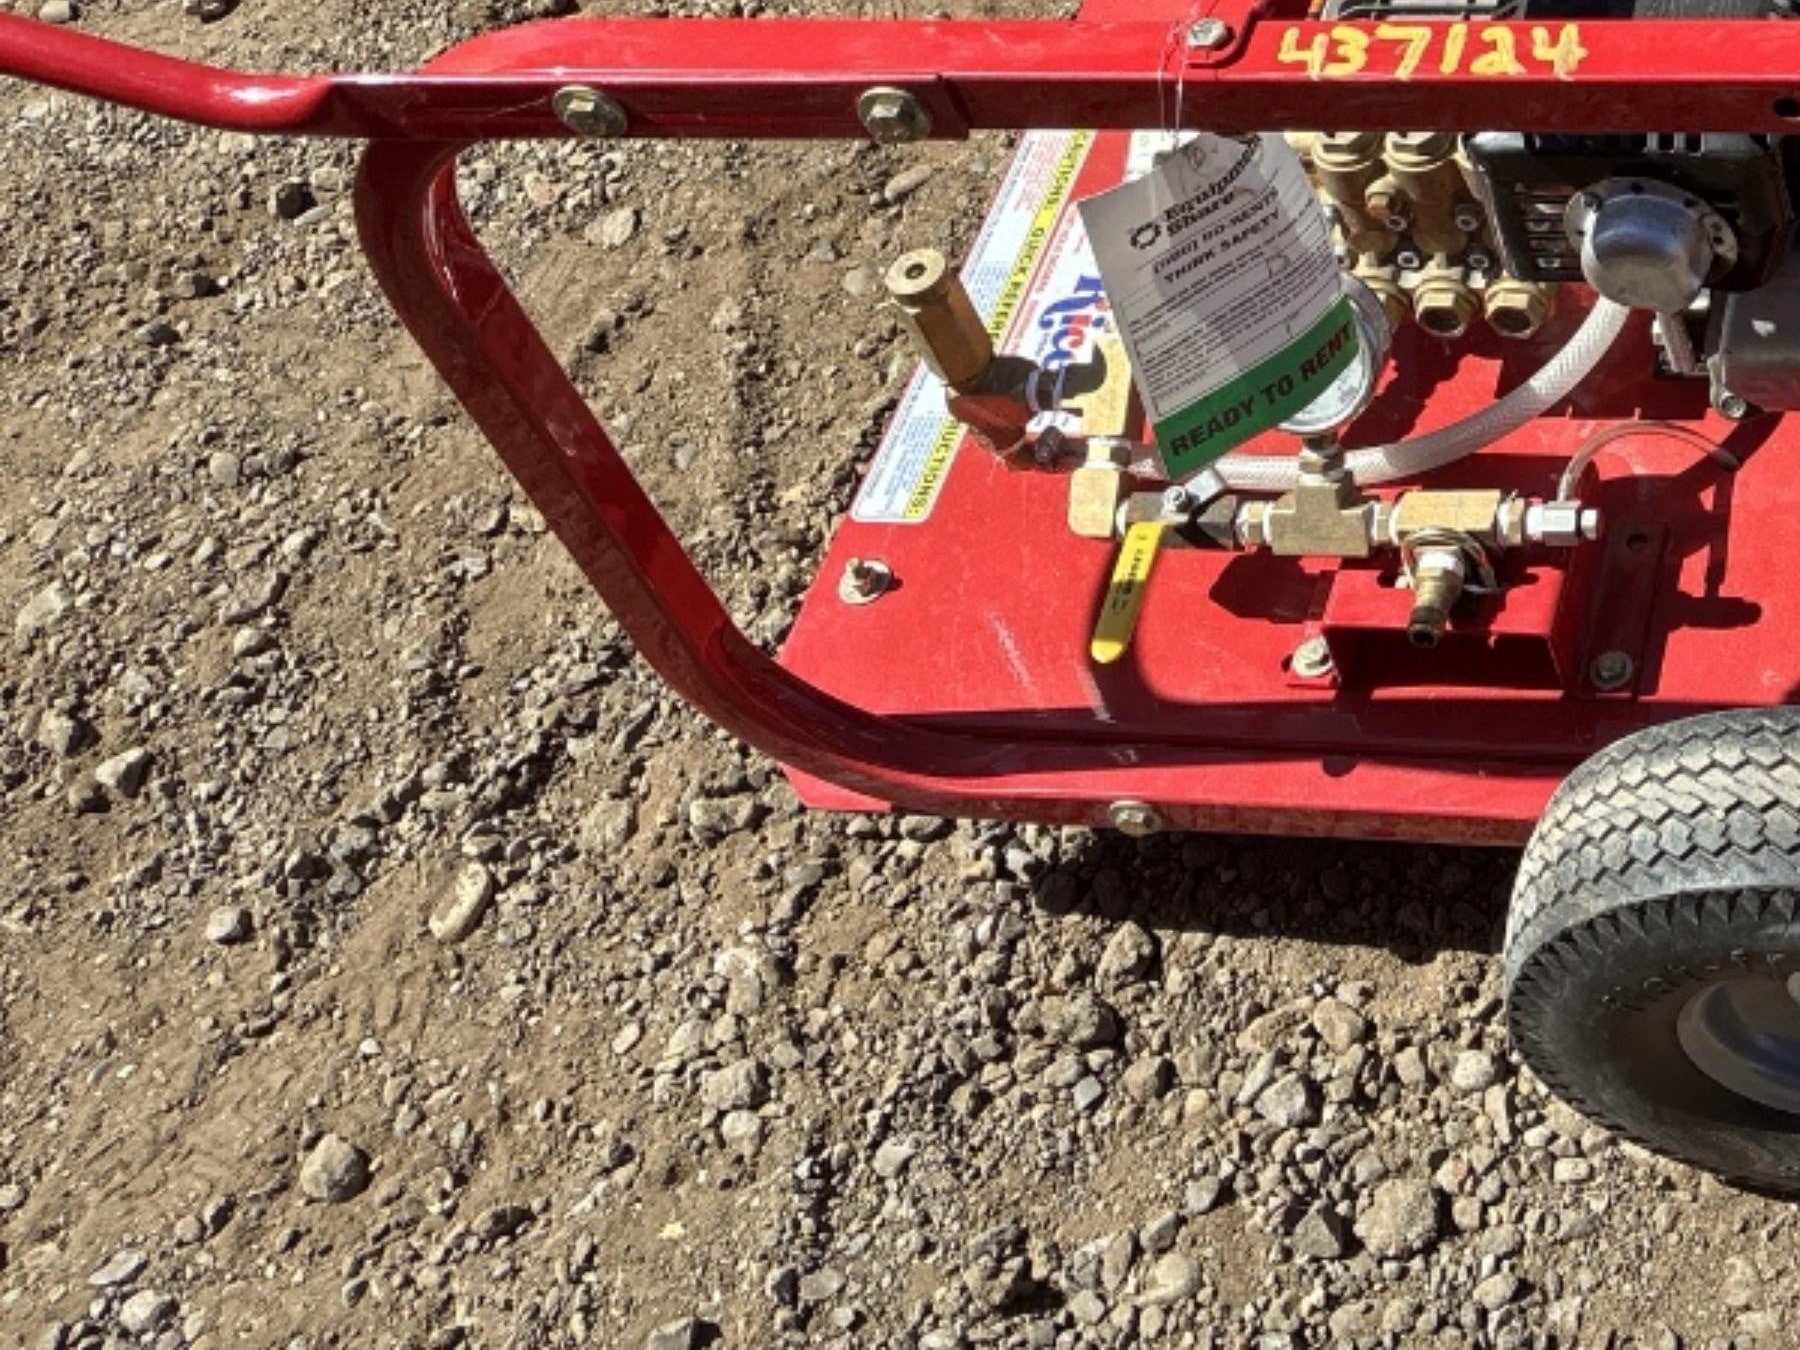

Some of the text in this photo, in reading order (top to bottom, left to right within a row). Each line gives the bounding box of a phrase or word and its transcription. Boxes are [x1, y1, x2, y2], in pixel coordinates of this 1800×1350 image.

[1277, 22, 1589, 81] 437124
[1166, 191, 1235, 238] Share
[1163, 211, 1282, 285] THINK SAFETY
[1169, 321, 1354, 457] READY TO RENT
